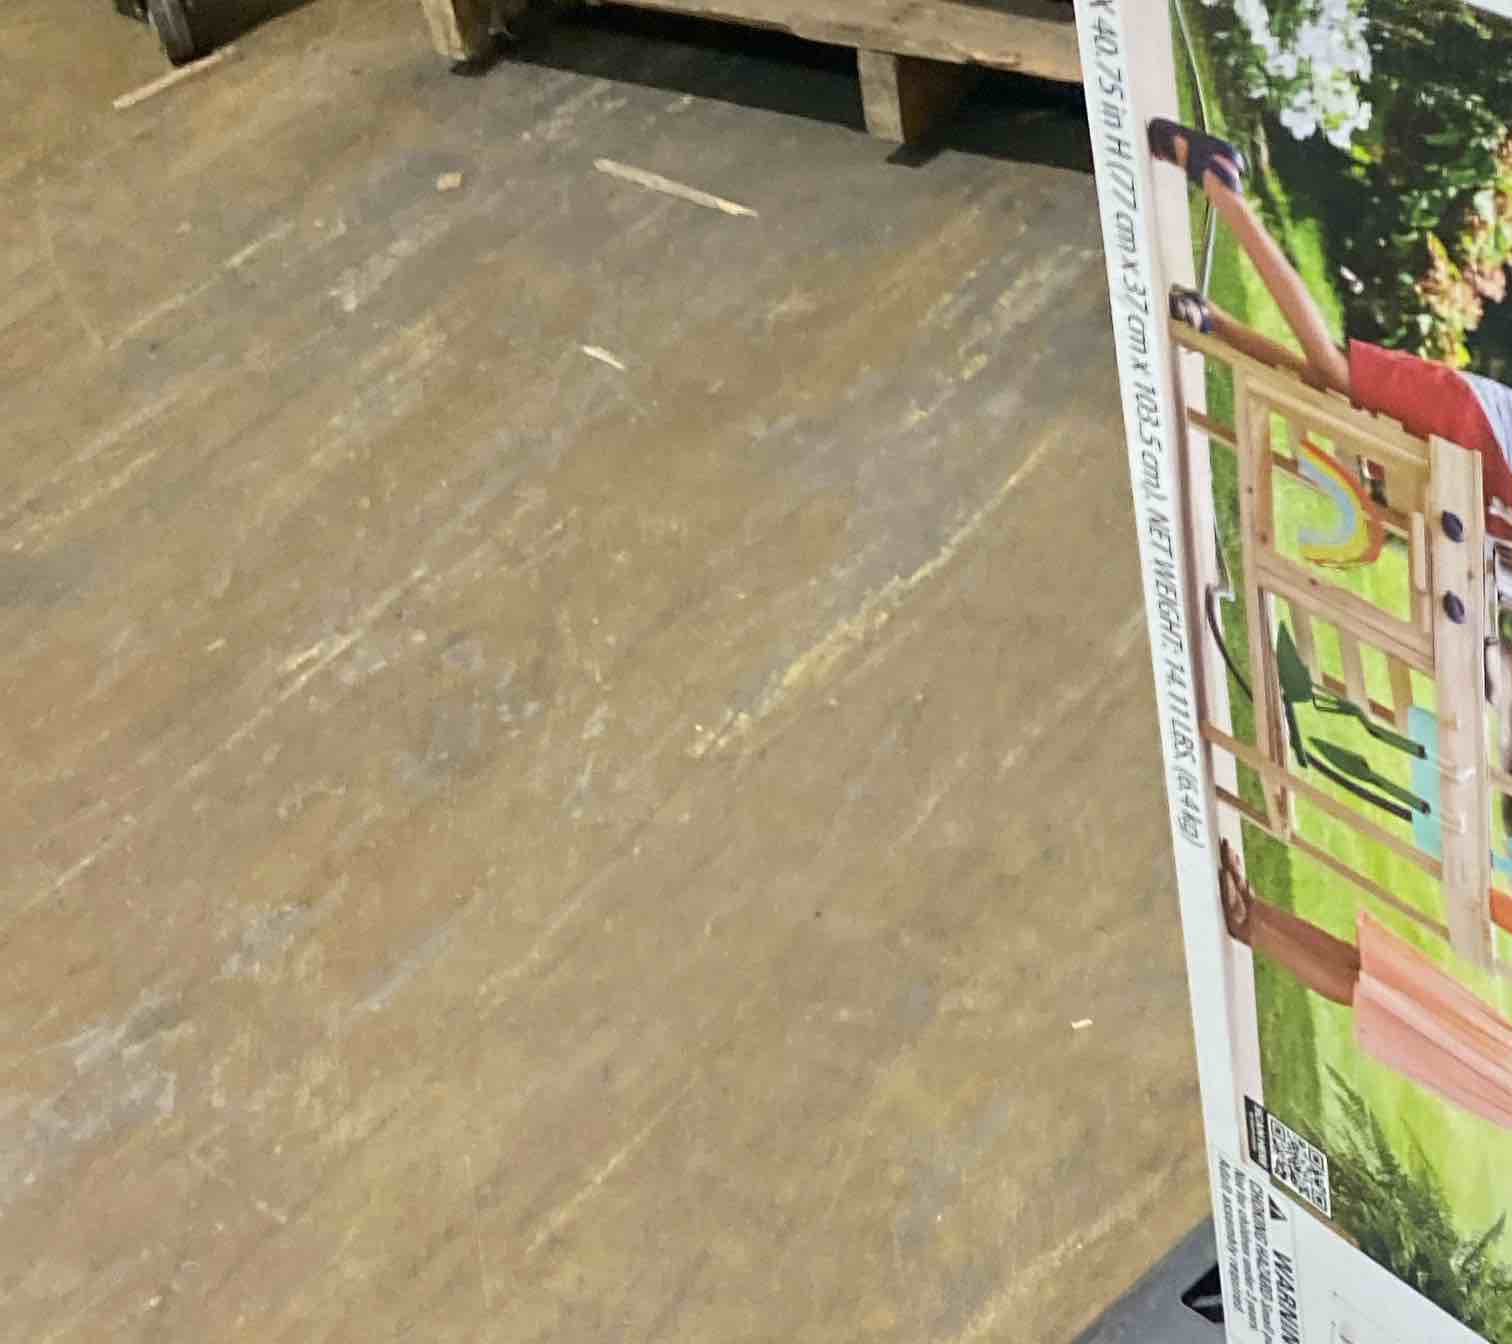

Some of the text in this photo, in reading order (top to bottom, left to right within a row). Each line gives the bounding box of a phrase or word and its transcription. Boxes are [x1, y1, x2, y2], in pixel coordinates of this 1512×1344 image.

[1093, 16, 1123, 100] 40.75
[1102, 105, 1126, 129] in
[1105, 134, 1132, 161] H
[1104, 163, 1137, 212] (77
[1117, 212, 1136, 253] cm
[1124, 276, 1148, 315] 37
[1128, 315, 1147, 355] cm
[1134, 382, 1161, 452] 103.5
[1142, 452, 1168, 501] cm)
[1147, 508, 1172, 559] NET
[1154, 559, 1183, 652] WEIGHT:
[1165, 659, 1190, 719] 14.11
[1172, 720, 1197, 764] LBS
